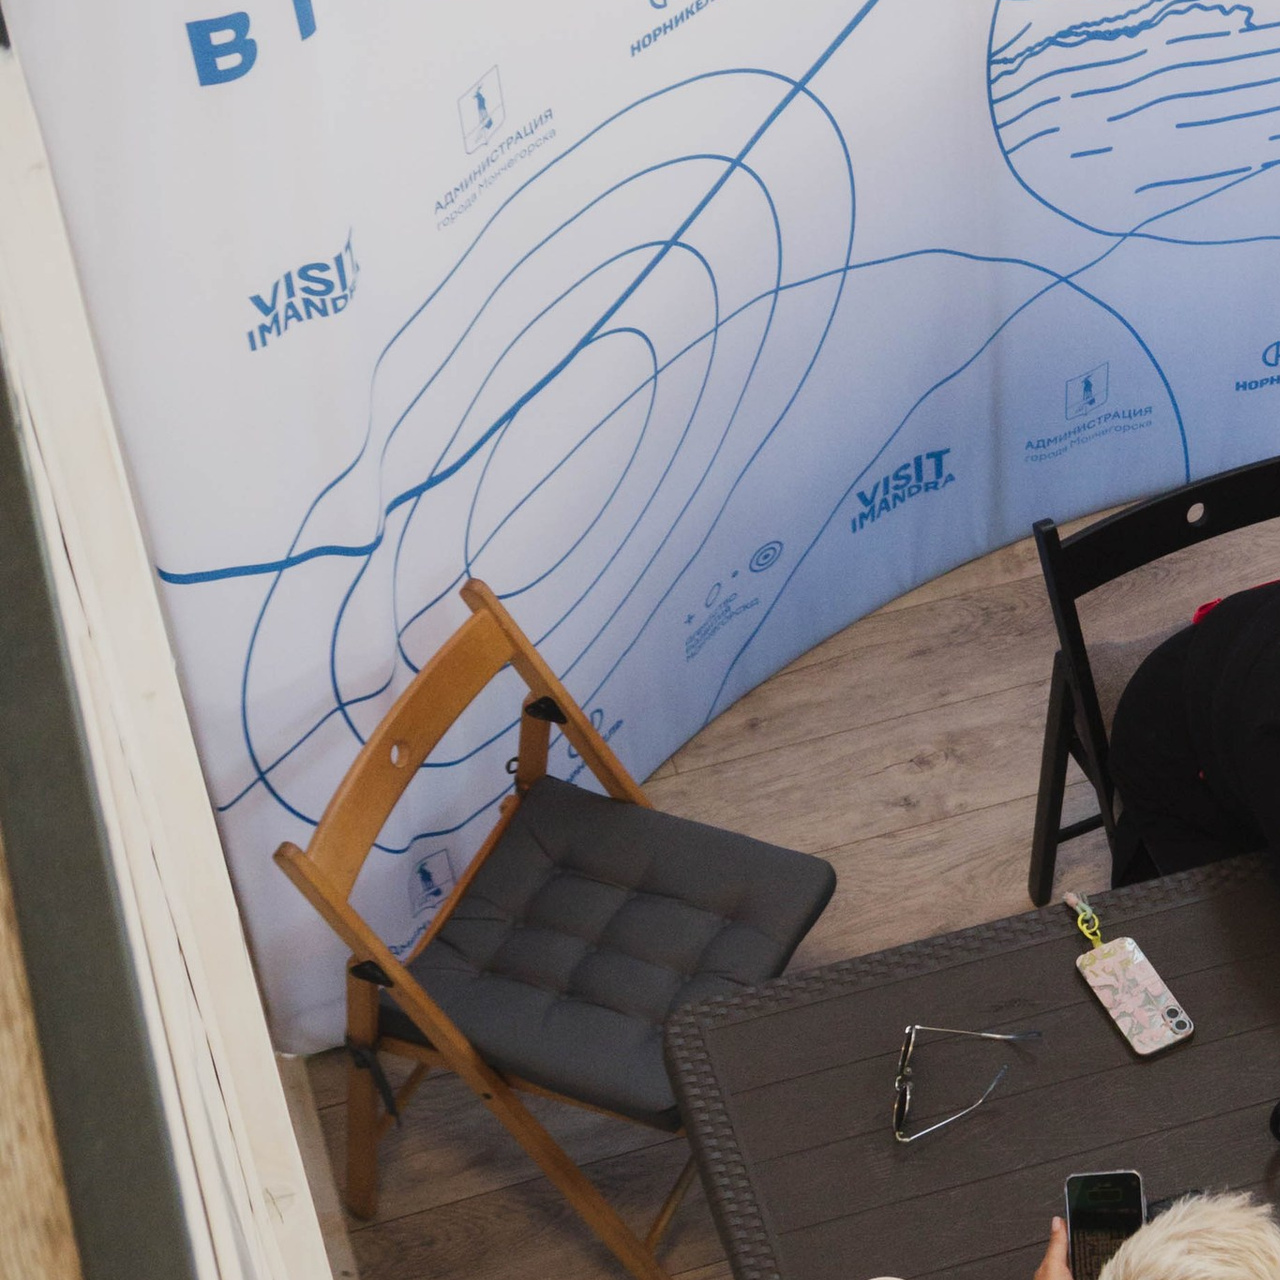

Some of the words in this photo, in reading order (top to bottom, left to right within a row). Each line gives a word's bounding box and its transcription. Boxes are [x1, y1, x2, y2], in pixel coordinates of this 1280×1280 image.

[185, 10, 258, 87] в
[434, 107, 554, 215] АДМИНИСТРАЦИЯ
[247, 281, 356, 352] IMAND
[1025, 406, 1153, 451] АДМИНИСТРАЦИЯ
[851, 473, 956, 534] IMANDRA
[856, 447, 951, 508] VISIT
